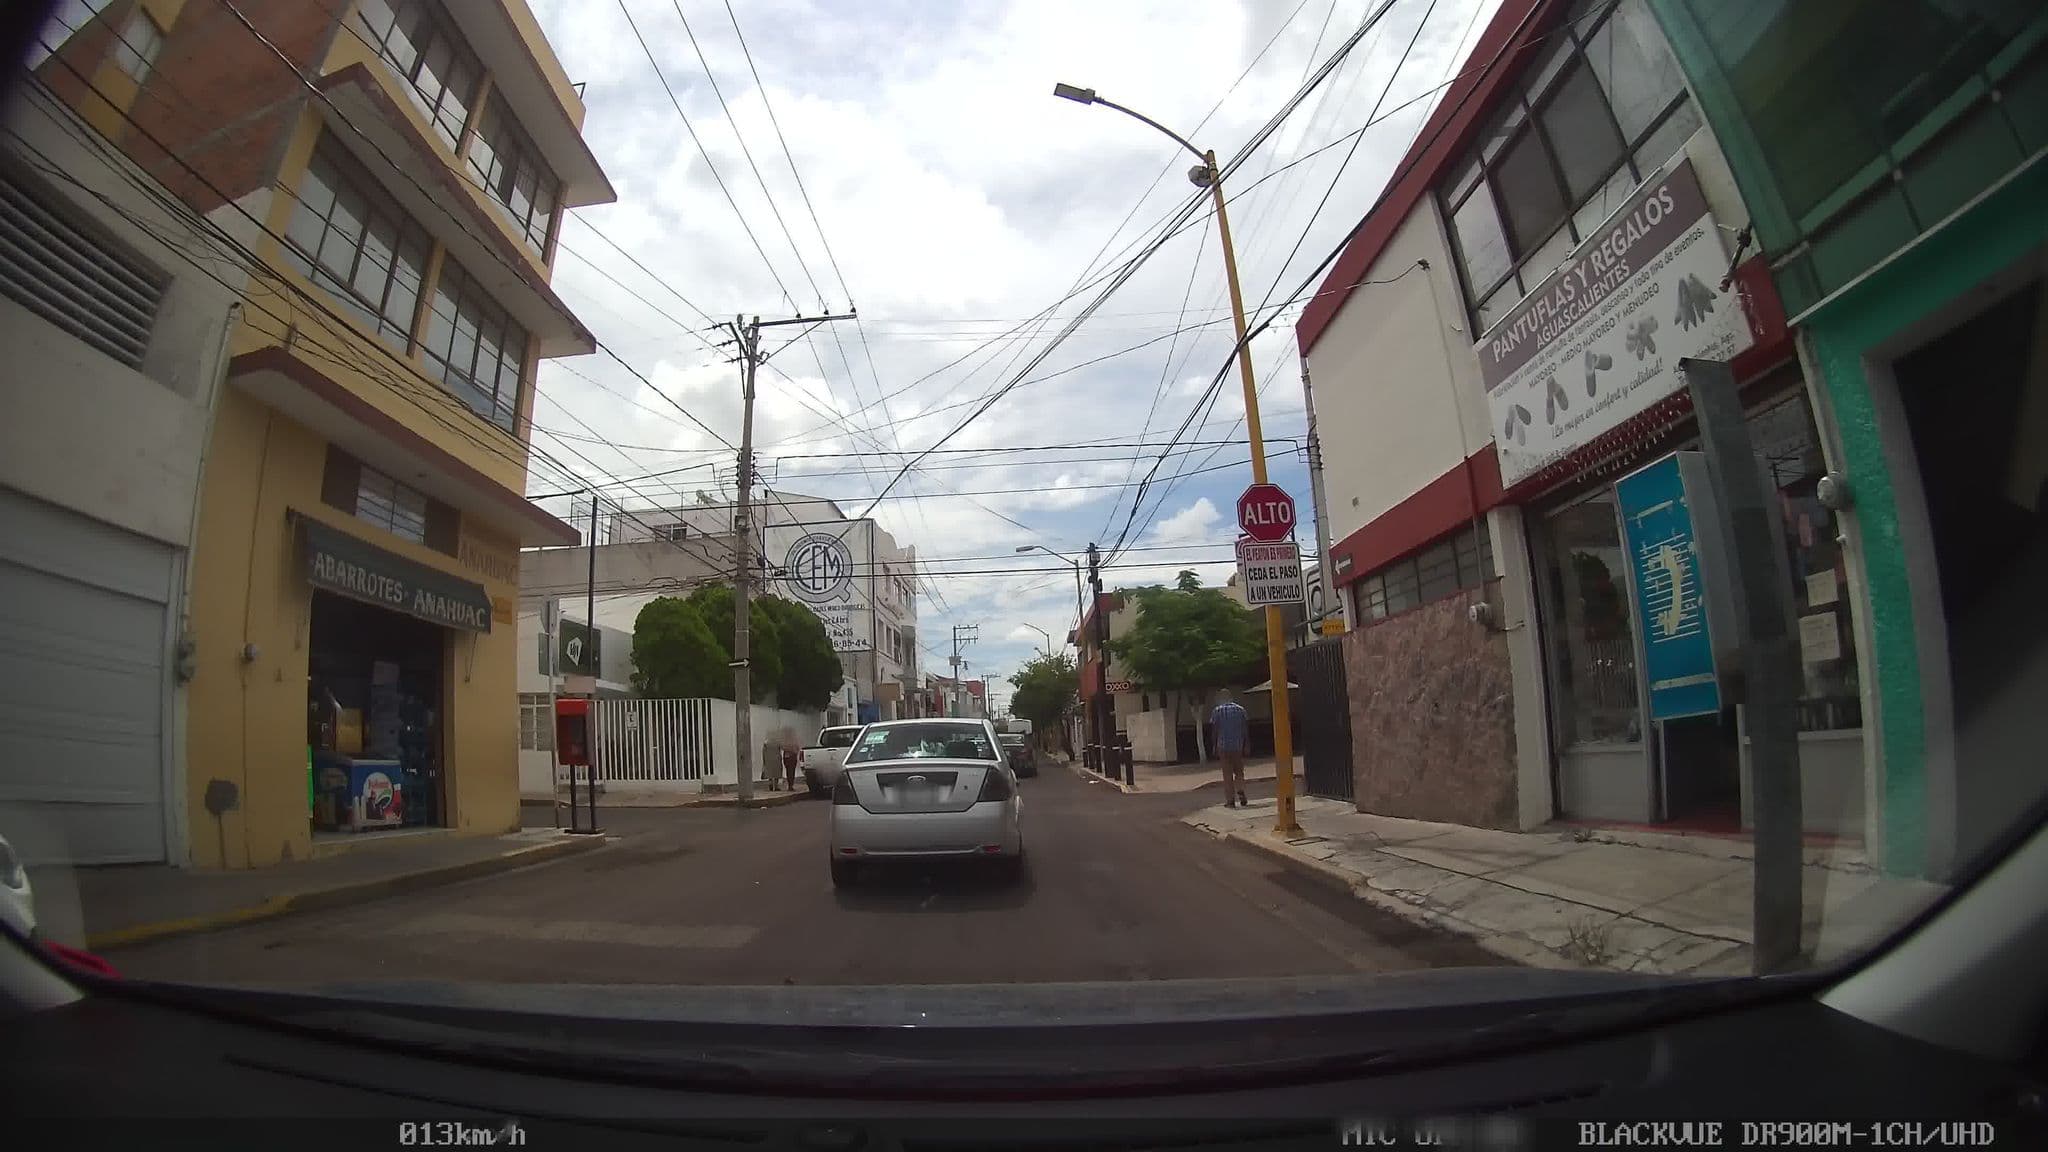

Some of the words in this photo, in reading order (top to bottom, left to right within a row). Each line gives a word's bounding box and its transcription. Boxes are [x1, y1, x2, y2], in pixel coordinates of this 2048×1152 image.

[1492, 276, 1575, 363] PANTUFLAS
[1575, 260, 1588, 288] Y
[1591, 185, 1674, 277] REGALOS
[1634, 270, 1650, 288] todo
[1664, 250, 1674, 264] de
[1536, 258, 1631, 349] AGUASCALIENTES
[1561, 343, 1582, 363] MEDIO
[1582, 317, 1616, 347] MAYOREO
[1622, 282, 1660, 318] MENUDEO
[1244, 502, 1291, 526] ALTO
[1246, 548, 1252, 561] EL
[1270, 547, 1276, 560] ES
[1248, 567, 1268, 581] CEDA
[1269, 567, 1279, 579] EL
[1279, 566, 1298, 579] PASO
[313, 552, 403, 603] ABARROTES
[414, 589, 486, 627] ANAHUAC
[1251, 587, 1256, 601] A
[1257, 586, 1267, 601] UN
[1267, 585, 1299, 600] VEHICULO
[1105, 682, 1130, 692] OXXO
